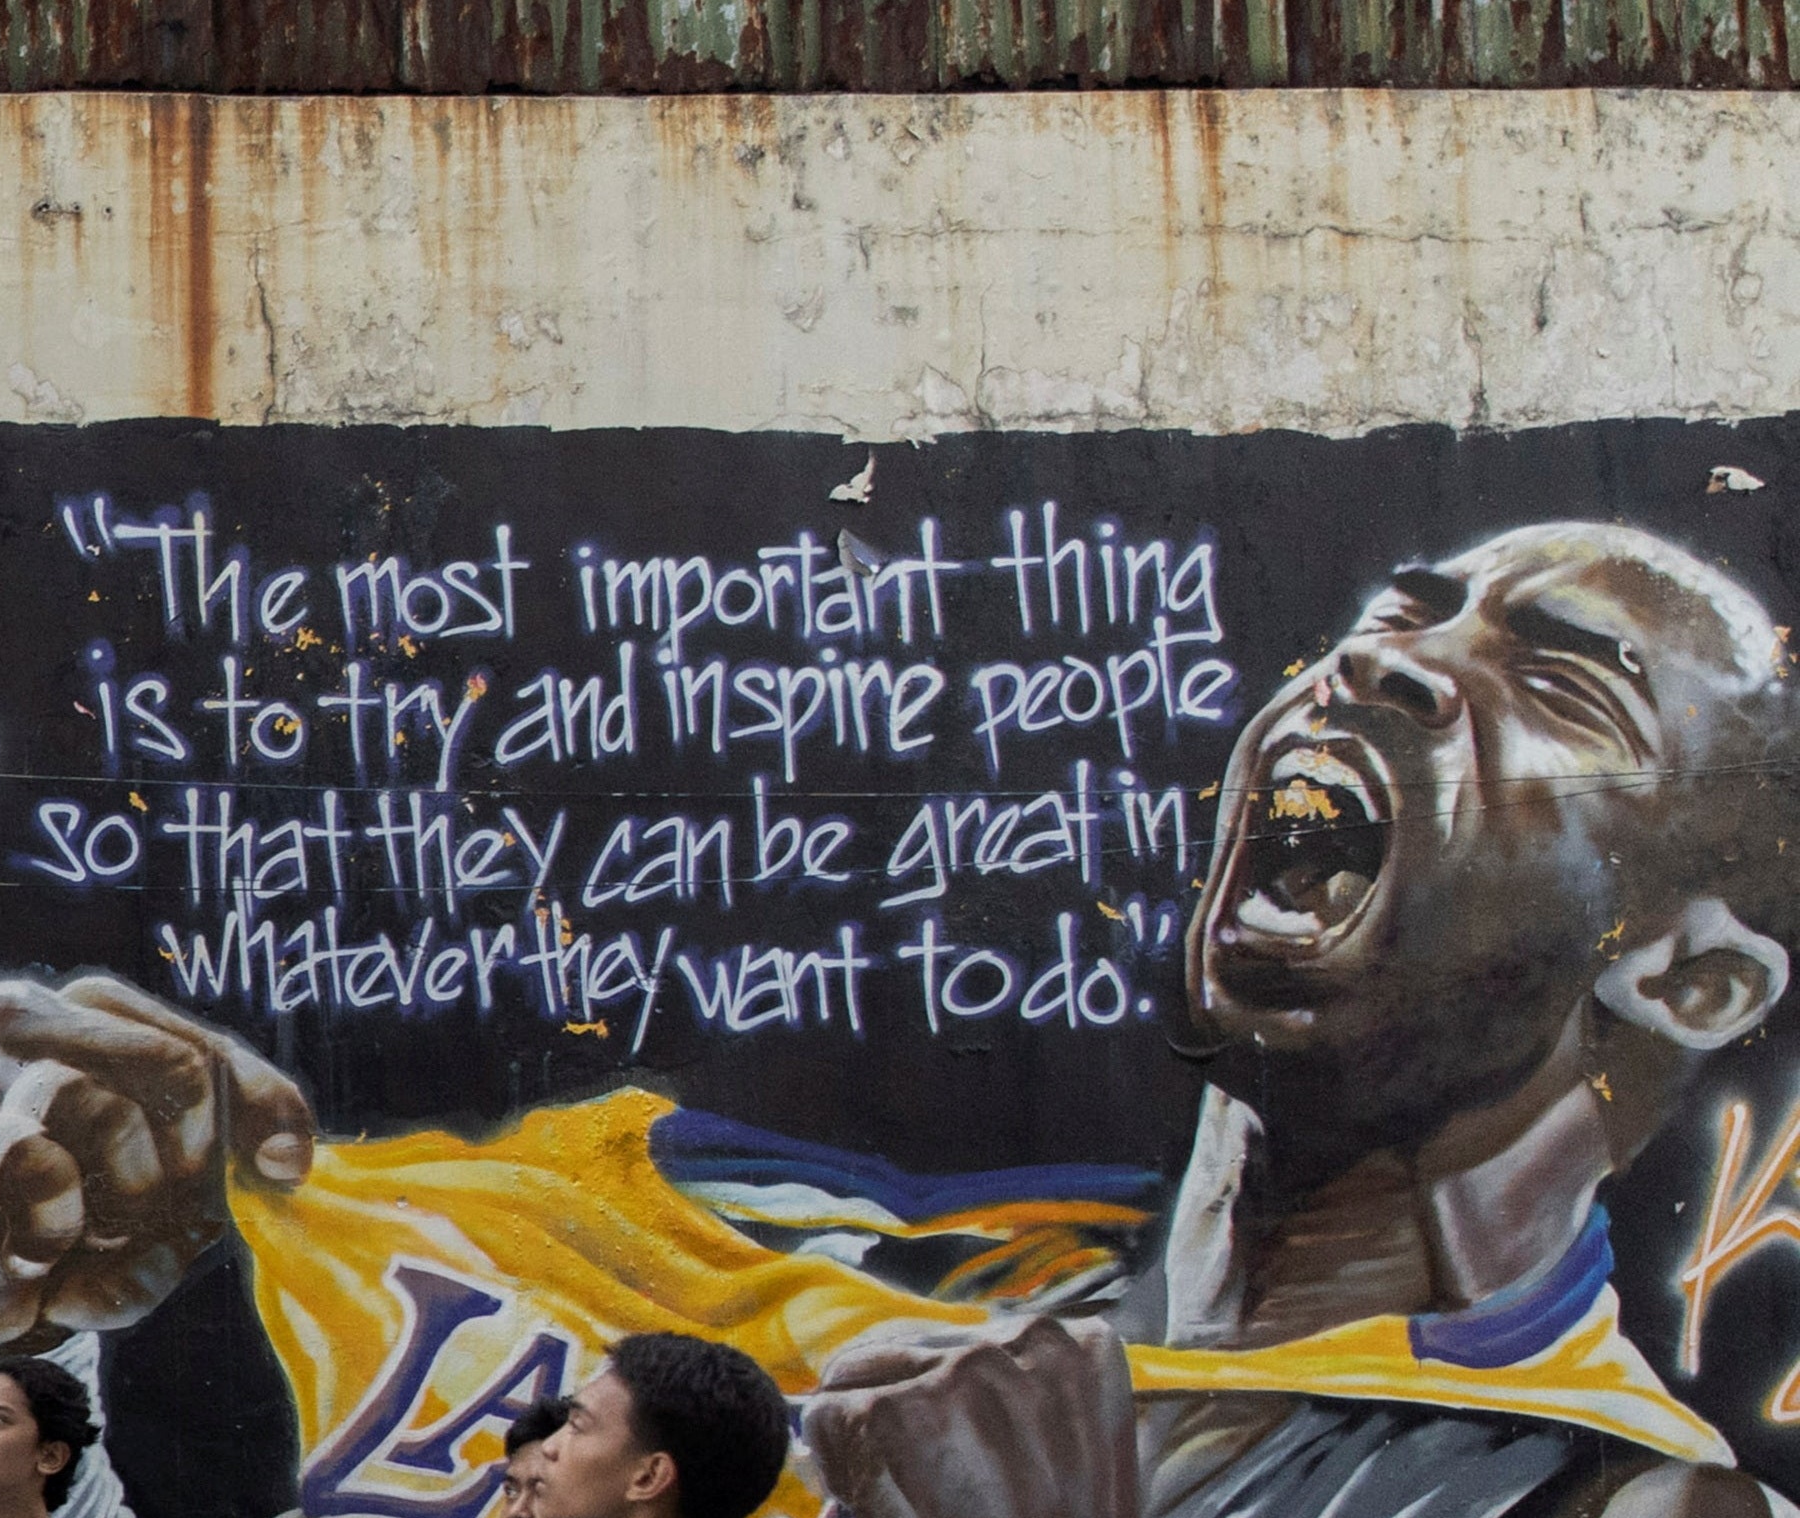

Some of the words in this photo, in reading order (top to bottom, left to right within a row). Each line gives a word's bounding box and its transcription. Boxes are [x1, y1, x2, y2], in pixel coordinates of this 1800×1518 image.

[338, 524, 530, 638] most
[577, 518, 962, 662] important
[992, 501, 1223, 643] thing
[90, 648, 187, 761] is
[203, 656, 302, 766] to
[317, 661, 484, 792] try
[494, 641, 634, 765] and
[656, 648, 946, 784] inspire
[971, 615, 1234, 774] people
[30, 802, 140, 883] so
[162, 788, 351, 906] that
[365, 792, 566, 914] they
[582, 816, 734, 910] can
[751, 776, 852, 883] be
[878, 758, 1100, 909] great
[1114, 770, 1188, 872] in
[159, 876, 515, 1011] whatever
[519, 900, 672, 1056] they
[676, 926, 871, 1033] want
[898, 918, 1013, 1035] to
